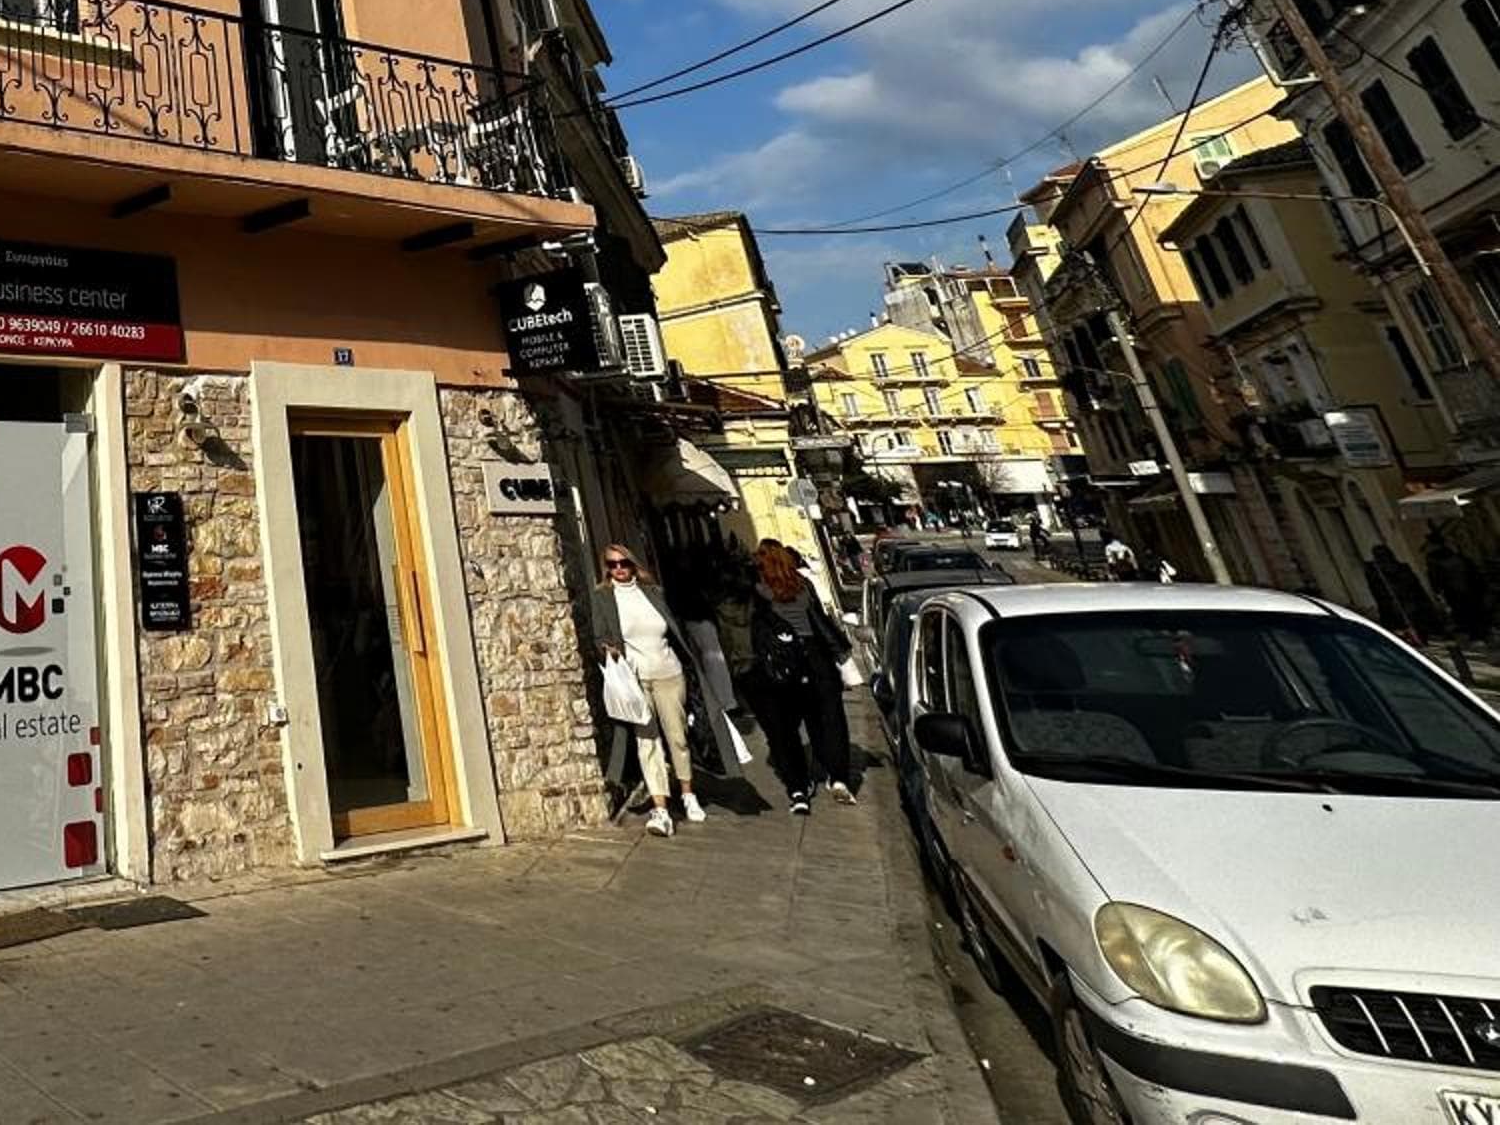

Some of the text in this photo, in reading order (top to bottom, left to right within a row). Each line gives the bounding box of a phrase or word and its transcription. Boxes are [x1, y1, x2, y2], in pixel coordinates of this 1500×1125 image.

[69, 286, 128, 311] center
[71, 322, 107, 337] 26610
[110, 325, 145, 340] 40283
[507, 307, 573, 332] CUBEtech
[15, 710, 81, 739] estate
